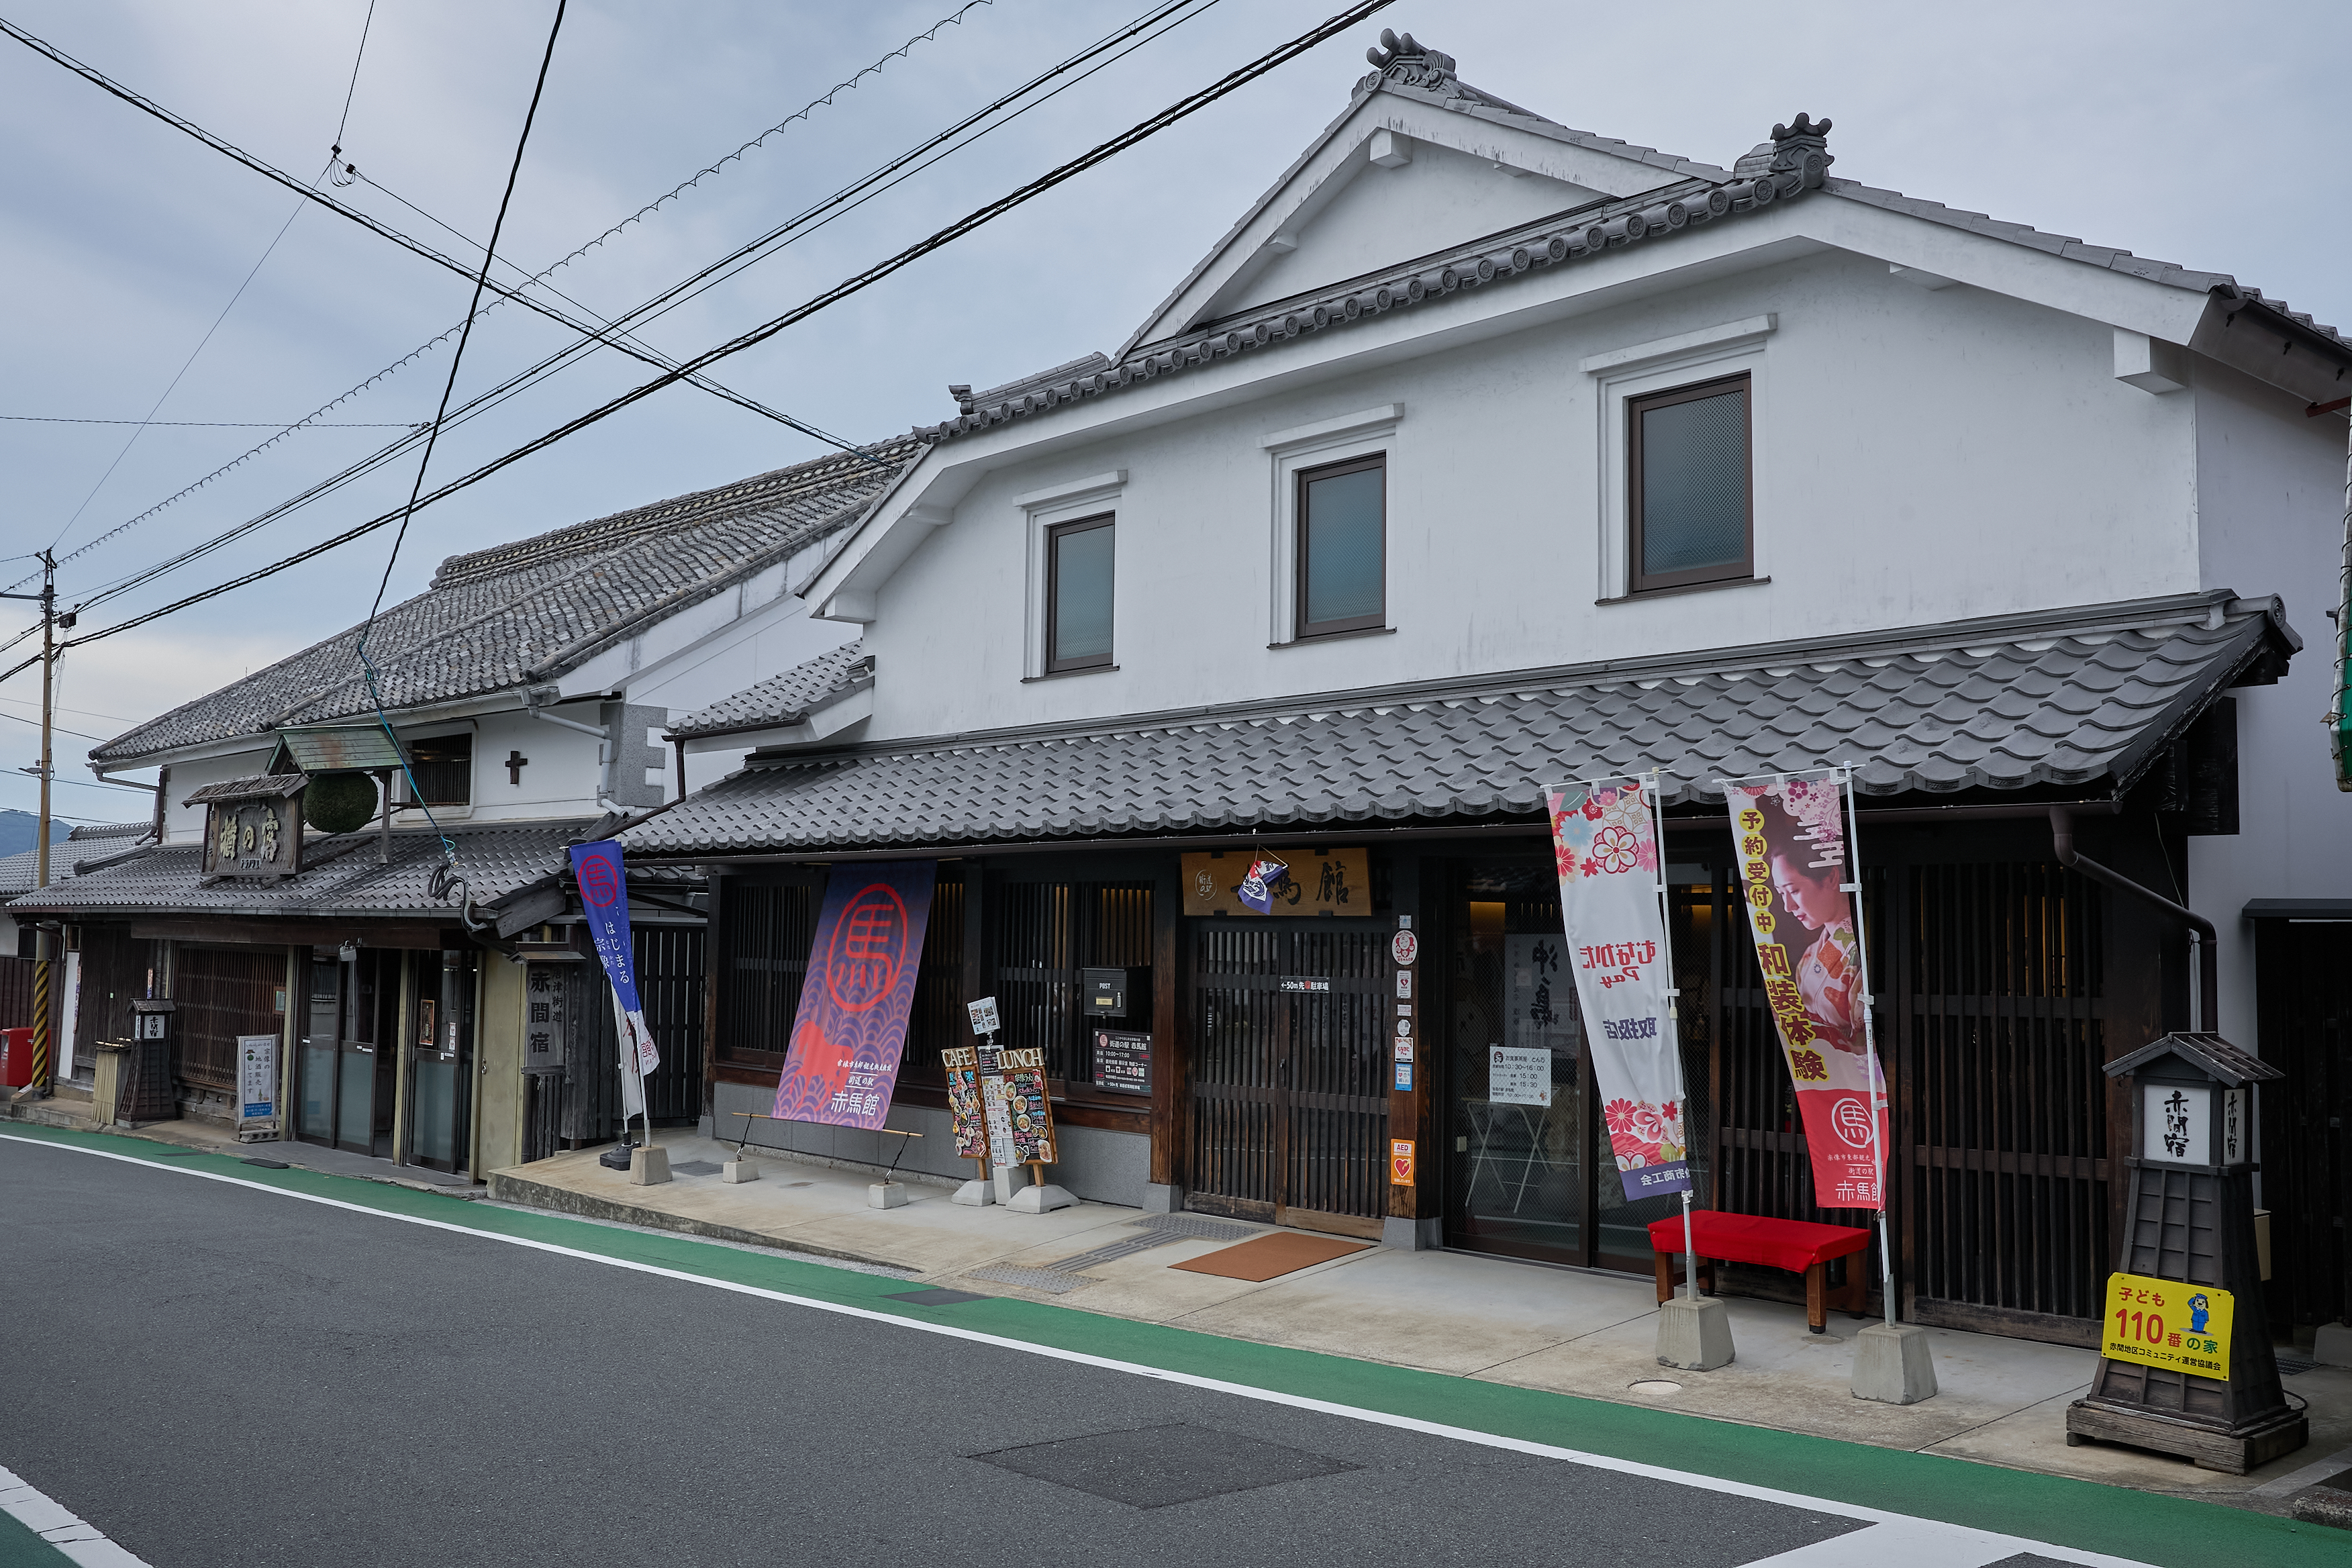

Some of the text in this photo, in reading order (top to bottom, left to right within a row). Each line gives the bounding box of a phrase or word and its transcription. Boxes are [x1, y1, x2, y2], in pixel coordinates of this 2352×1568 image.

[1743, 812, 1772, 932] 予約受付中
[605, 922, 630, 983] はじまる
[552, 967, 563, 1022] 唐津街道
[530, 971, 550, 1053] 赤間宿
[1758, 944, 1828, 1080] 和装体験
[942, 1048, 973, 1067] CAFE
[995, 1048, 1045, 1069] LUNCH
[1110, 1040, 1146, 1050] 街道の駅 赤馬館
[848, 1075, 874, 1086] 街道の駅
[831, 1090, 880, 1116] 赤馬館
[2163, 1090, 2190, 1158] 赤間宿
[2227, 1091, 2237, 1159] 赤間宿
[1848, 1167, 1874, 1175] 街道の駅
[2119, 1287, 2165, 1307] 子ども
[2109, 1342, 2221, 1371] 赤間地区コミュニティ運営協議会
